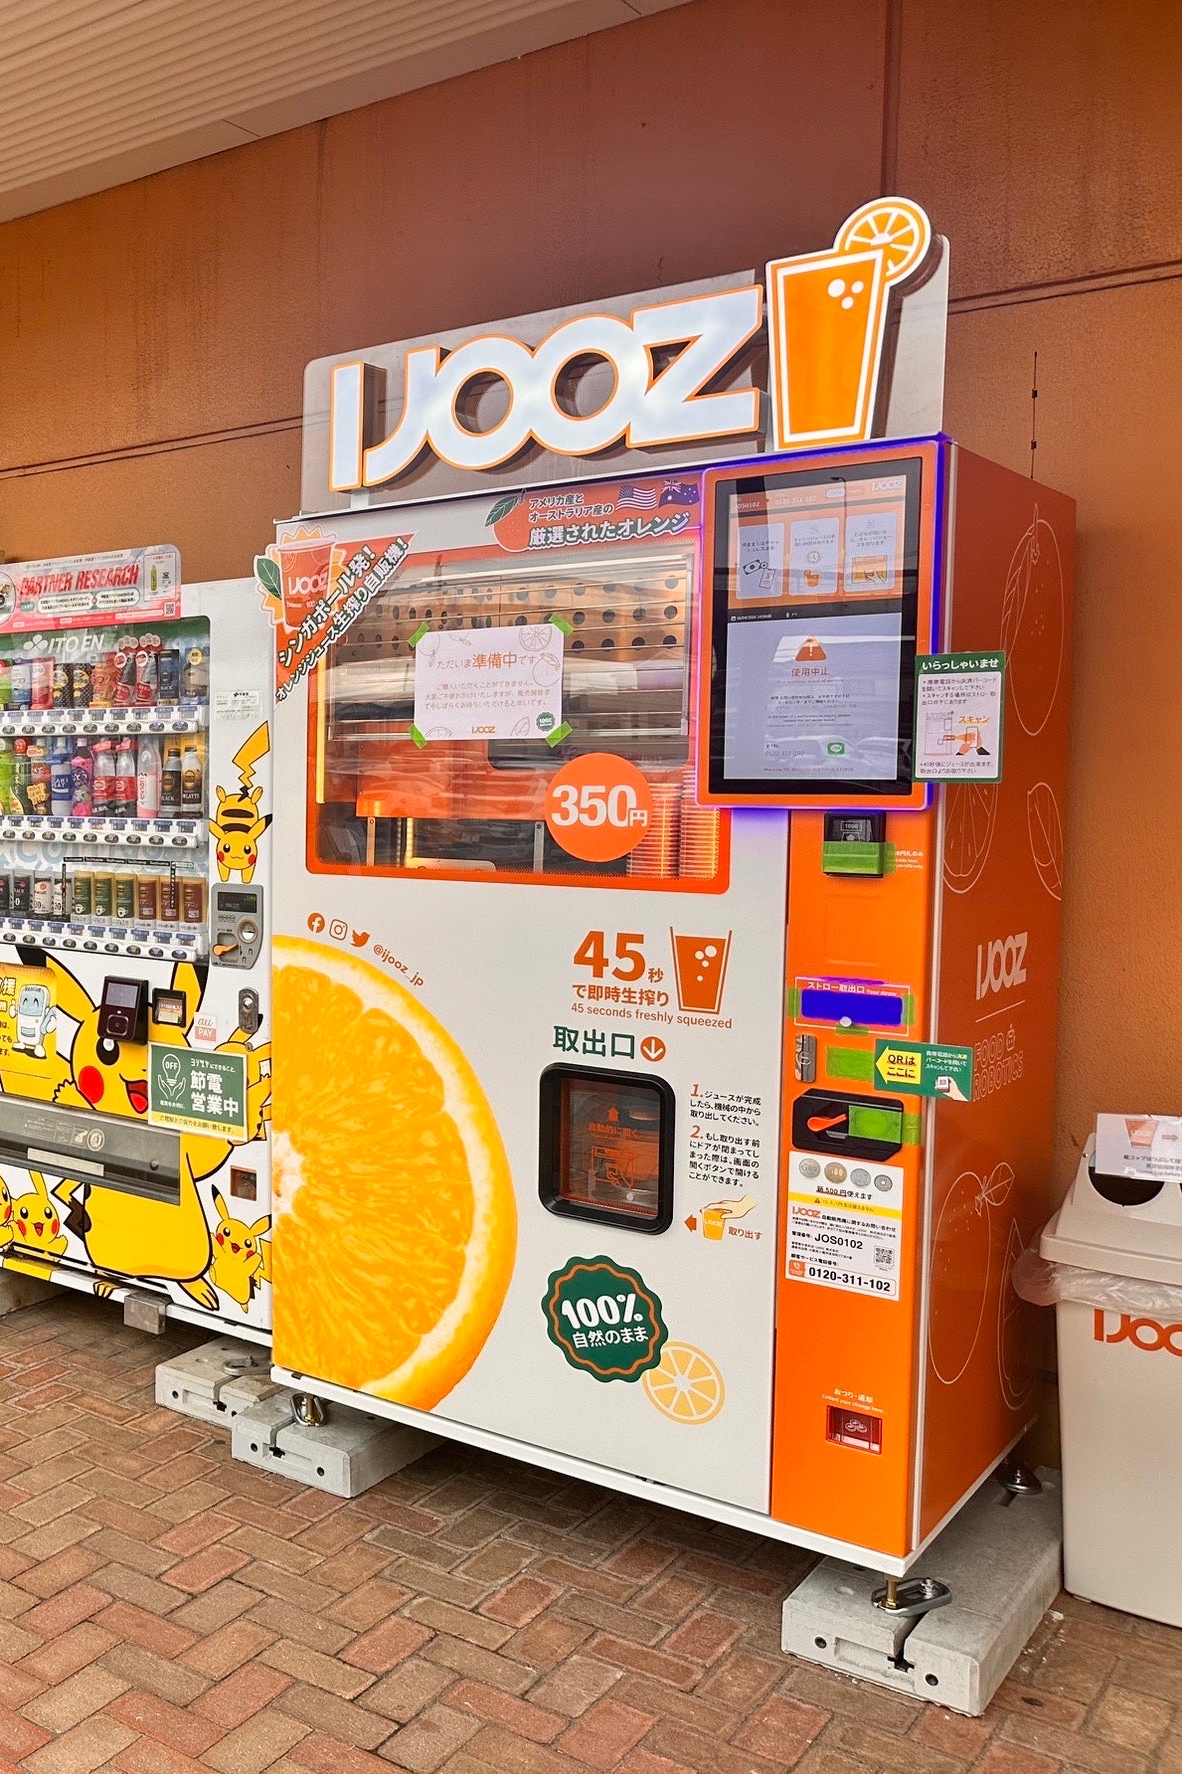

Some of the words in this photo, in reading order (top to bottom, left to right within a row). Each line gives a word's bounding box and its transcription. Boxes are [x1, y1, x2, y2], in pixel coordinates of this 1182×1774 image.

[329, 284, 764, 491] IJOOZ
[529, 493, 584, 508] アメリカ産と
[529, 504, 613, 522] オーストラリア産の
[529, 512, 690, 547] 厳選されたオレンジ
[20, 571, 72, 596] PARTNER
[75, 564, 140, 591] RESEARCH
[288, 572, 328, 595] IJOOZ
[48, 635, 78, 654] ITO
[81, 634, 104, 652] EN
[437, 651, 537, 670] ただいま準備中です
[922, 658, 999, 670] いらっしゃいませ
[791, 667, 830, 677] 使用中止
[958, 715, 990, 724] スキャン
[471, 726, 496, 735] IJOOZ
[551, 784, 648, 827] 350円
[373, 944, 425, 987] @ijooz_jp
[573, 930, 664, 983] 45秒
[975, 932, 1028, 1001] IJOOZ
[571, 984, 669, 1007] で即時生搾り
[808, 981, 865, 994] ストロー取出口
[197, 1017, 214, 1027] au
[571, 1002, 584, 1013] 45
[587, 1005, 632, 1019] seconds
[635, 1008, 674, 1025] freshly
[676, 1013, 732, 1029] squeezed
[197, 1029, 213, 1039] PAY
[552, 1025, 635, 1060] 取出口
[165, 1061, 178, 1071] OFF
[887, 1054, 916, 1066] QRは
[887, 1066, 916, 1078] ここに
[190, 1070, 223, 1094] 節電
[191, 1092, 239, 1118] 営業中
[704, 1091, 761, 1105] ジュースが完成
[690, 1099, 761, 1116] したら、機械の中から
[690, 1109, 759, 1127] 取り出してください。
[706, 1132, 760, 1148] もし取り出す前
[689, 1171, 743, 1187] ことができます。
[792, 1206, 821, 1218] IJOOZ
[728, 1226, 763, 1241] 取り出す
[814, 1233, 863, 1250] JOS0102
[809, 1267, 891, 1292] 0120-311-102
[561, 1293, 644, 1330] 100%
[572, 1326, 649, 1349] 自然のまま
